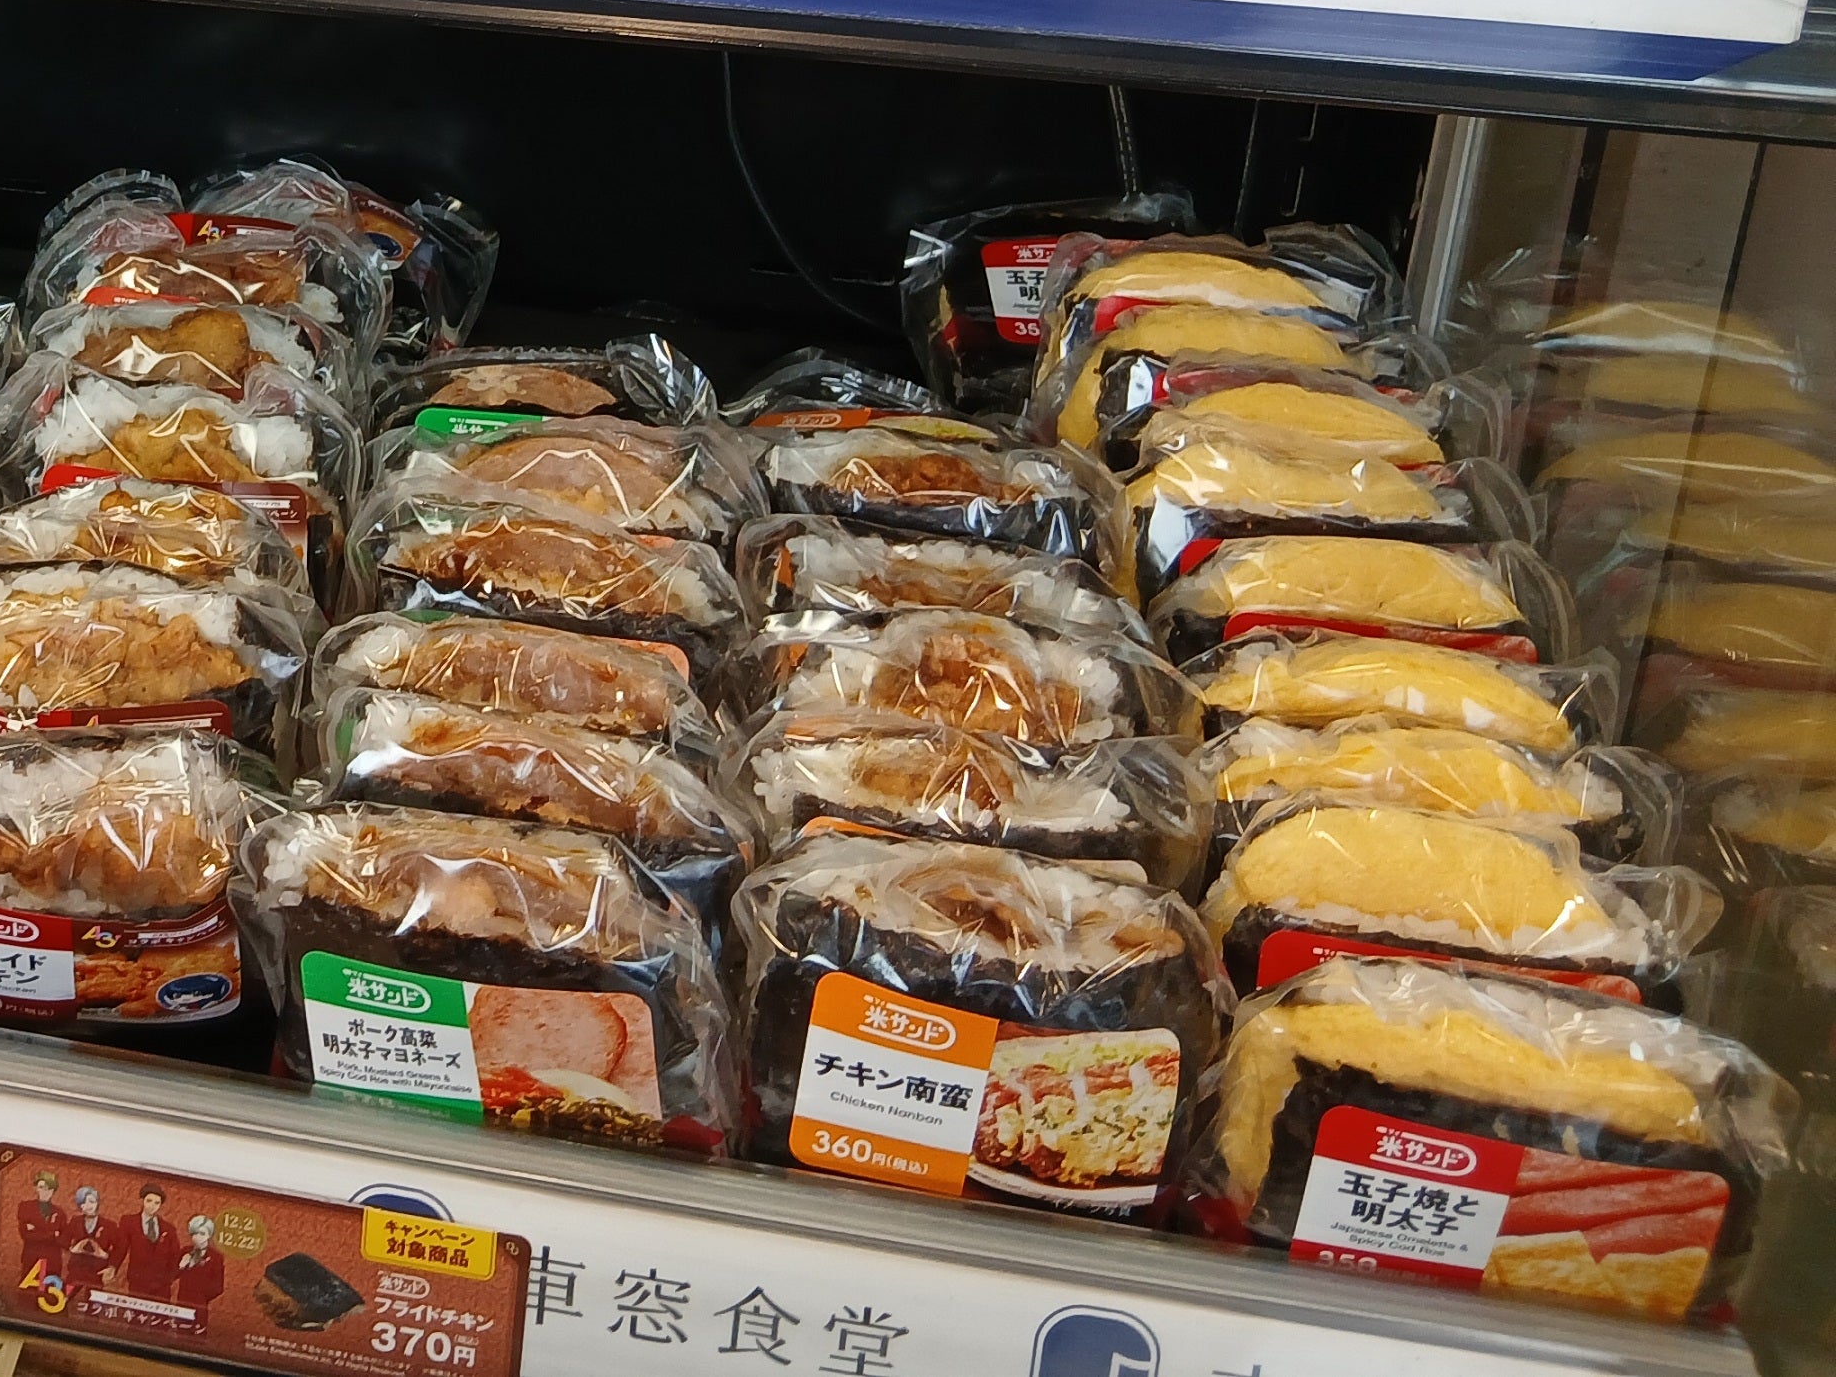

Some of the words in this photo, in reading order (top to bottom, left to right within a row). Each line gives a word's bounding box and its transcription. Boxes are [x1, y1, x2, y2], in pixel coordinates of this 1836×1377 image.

[347, 974, 420, 1007] 米サンド
[348, 1018, 438, 1049] ポーク高菜
[864, 1004, 946, 1042] 米サンド
[322, 1032, 462, 1070] 明太子マヨネーズ
[814, 1052, 974, 1112] チキン南蛮
[829, 1090, 885, 1113] Chicken
[888, 1105, 943, 1127] Nanban
[811, 1129, 930, 1176] 360円(税込)
[1376, 1135, 1465, 1169] 米サンド
[1337, 1169, 1480, 1217] 玉子焼と
[383, 1218, 477, 1248] キャンペーン
[1330, 1221, 1393, 1240] Japanese
[1350, 1199, 1460, 1237] 明太子
[386, 1238, 471, 1269] 対象商品
[1387, 1241, 1416, 1253] Cod
[77, 1301, 118, 1318] コラボ
[122, 1308, 208, 1336] キャンペーン
[373, 1296, 495, 1333] フライドチキン
[525, 1245, 910, 1377] 車窓食堂
[370, 1321, 477, 1369] 370円
